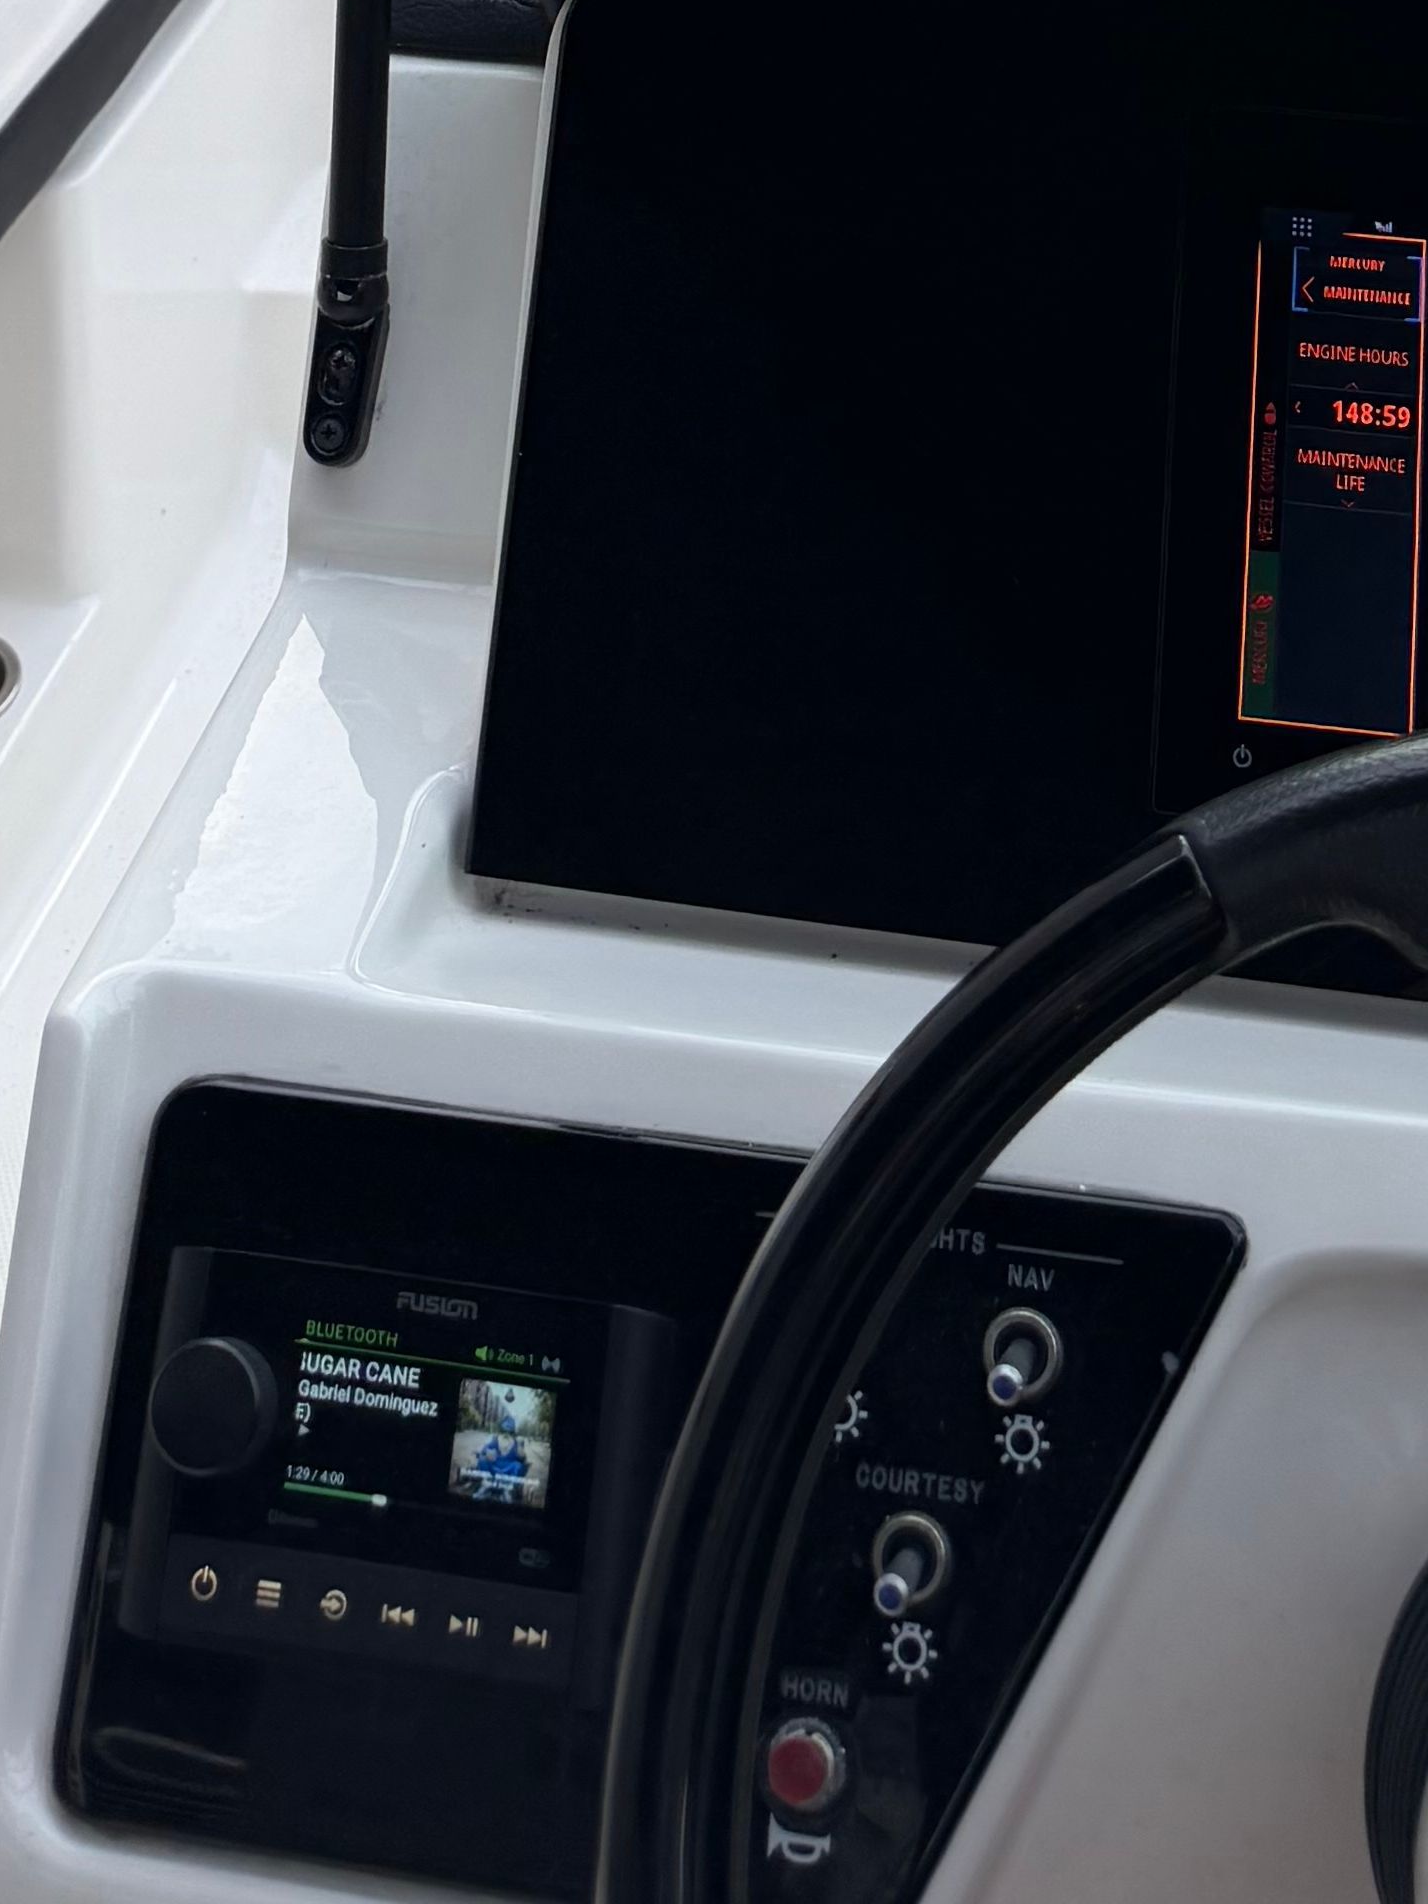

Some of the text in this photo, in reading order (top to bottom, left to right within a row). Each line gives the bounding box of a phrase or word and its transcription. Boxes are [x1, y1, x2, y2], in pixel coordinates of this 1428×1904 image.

[1329, 255, 1386, 272] MERCURY
[1323, 285, 1412, 306] MAINTENANCE
[1299, 342, 1410, 367] ENGINE HOURS
[1332, 399, 1412, 429] 148:59
[1297, 448, 1406, 474] MAINTENANCE
[1336, 474, 1366, 492] LIFE
[930, 1228, 987, 1256] HTS
[1007, 1263, 1056, 1292] NAV
[396, 1291, 479, 1320] FUSION
[305, 1319, 400, 1349] BLUETOOTH
[497, 1348, 526, 1365] Zone
[365, 1360, 422, 1389] CANE
[297, 1379, 439, 1417] Gabriel Dominguez
[855, 1462, 986, 1505] COURTESY
[780, 1672, 850, 1709] HORN
